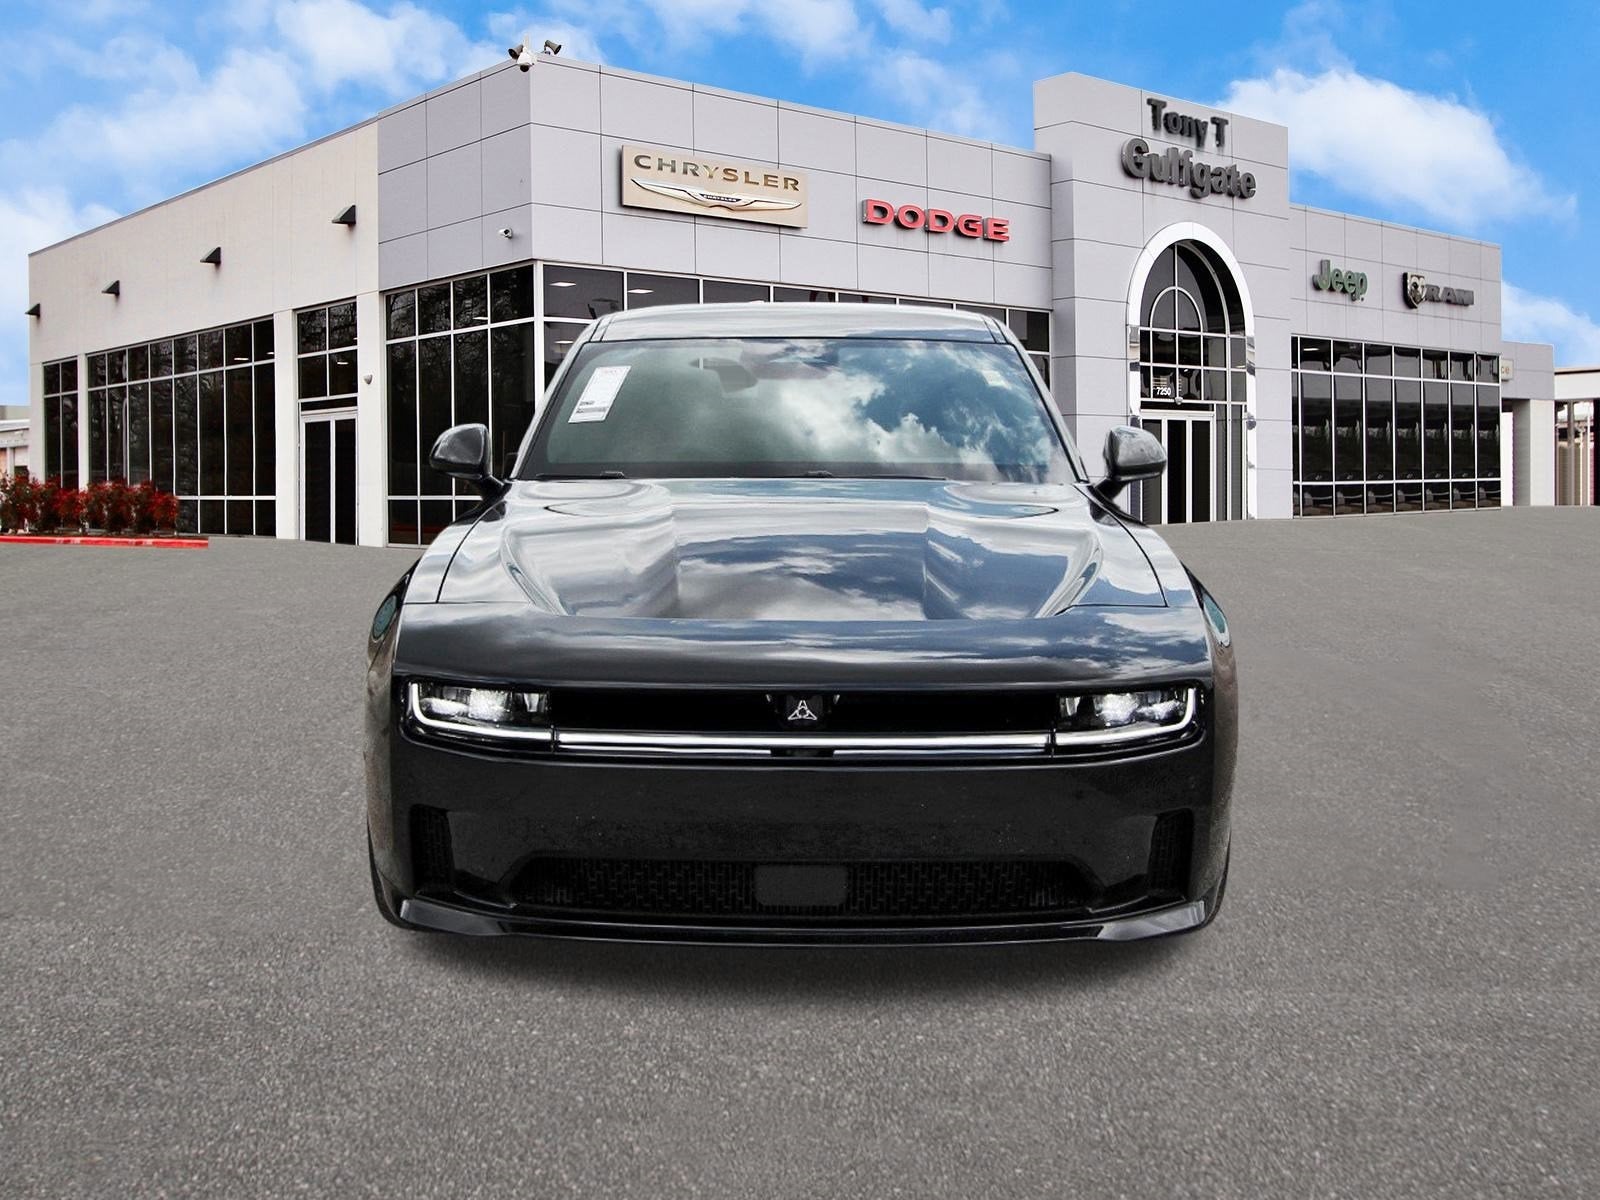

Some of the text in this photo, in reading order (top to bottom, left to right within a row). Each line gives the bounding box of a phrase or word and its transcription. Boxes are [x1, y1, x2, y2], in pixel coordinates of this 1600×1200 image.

[1147, 98, 1229, 147] Tony T
[634, 154, 800, 191] CHRYSLER
[1121, 138, 1257, 199] Gulfgate
[863, 199, 1010, 241] DODGE
[1312, 259, 1368, 301] Jeep
[1425, 283, 1475, 306] RAM
